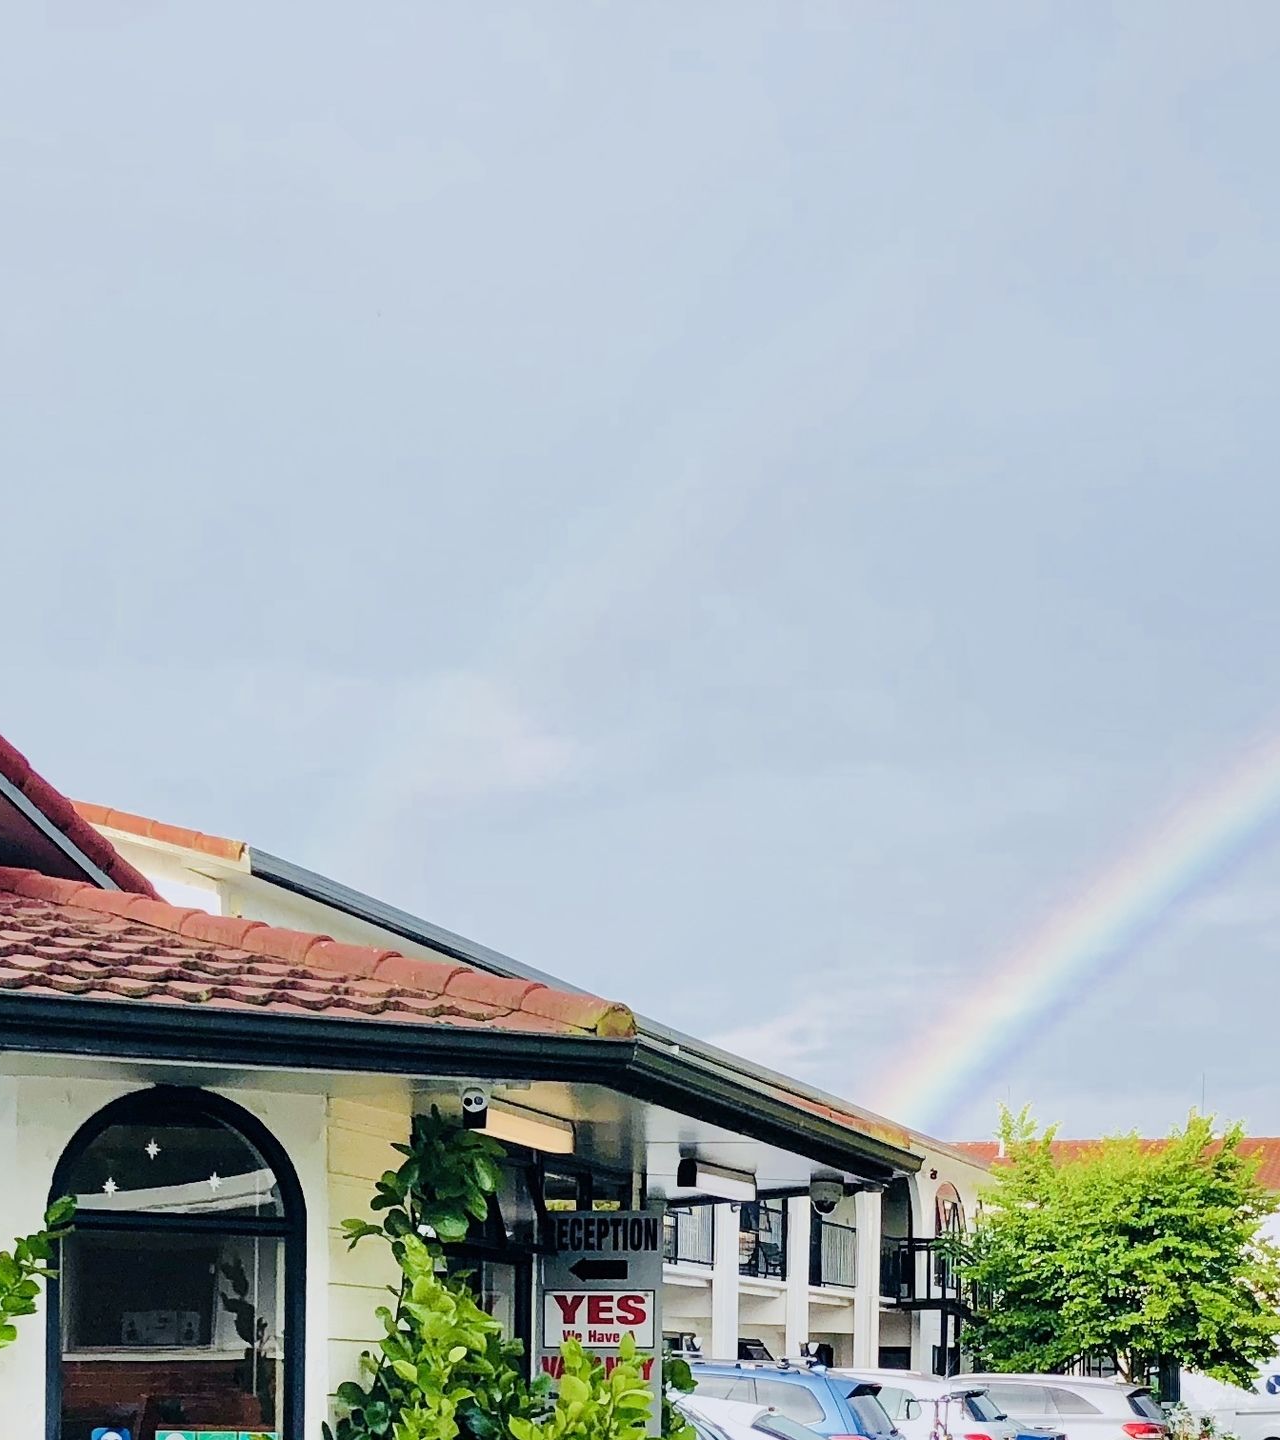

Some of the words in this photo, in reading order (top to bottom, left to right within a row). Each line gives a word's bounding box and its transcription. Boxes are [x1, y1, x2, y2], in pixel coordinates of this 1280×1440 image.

[553, 1295, 647, 1325] YES
[562, 1330, 583, 1343] We
[588, 1330, 620, 1343] Have
